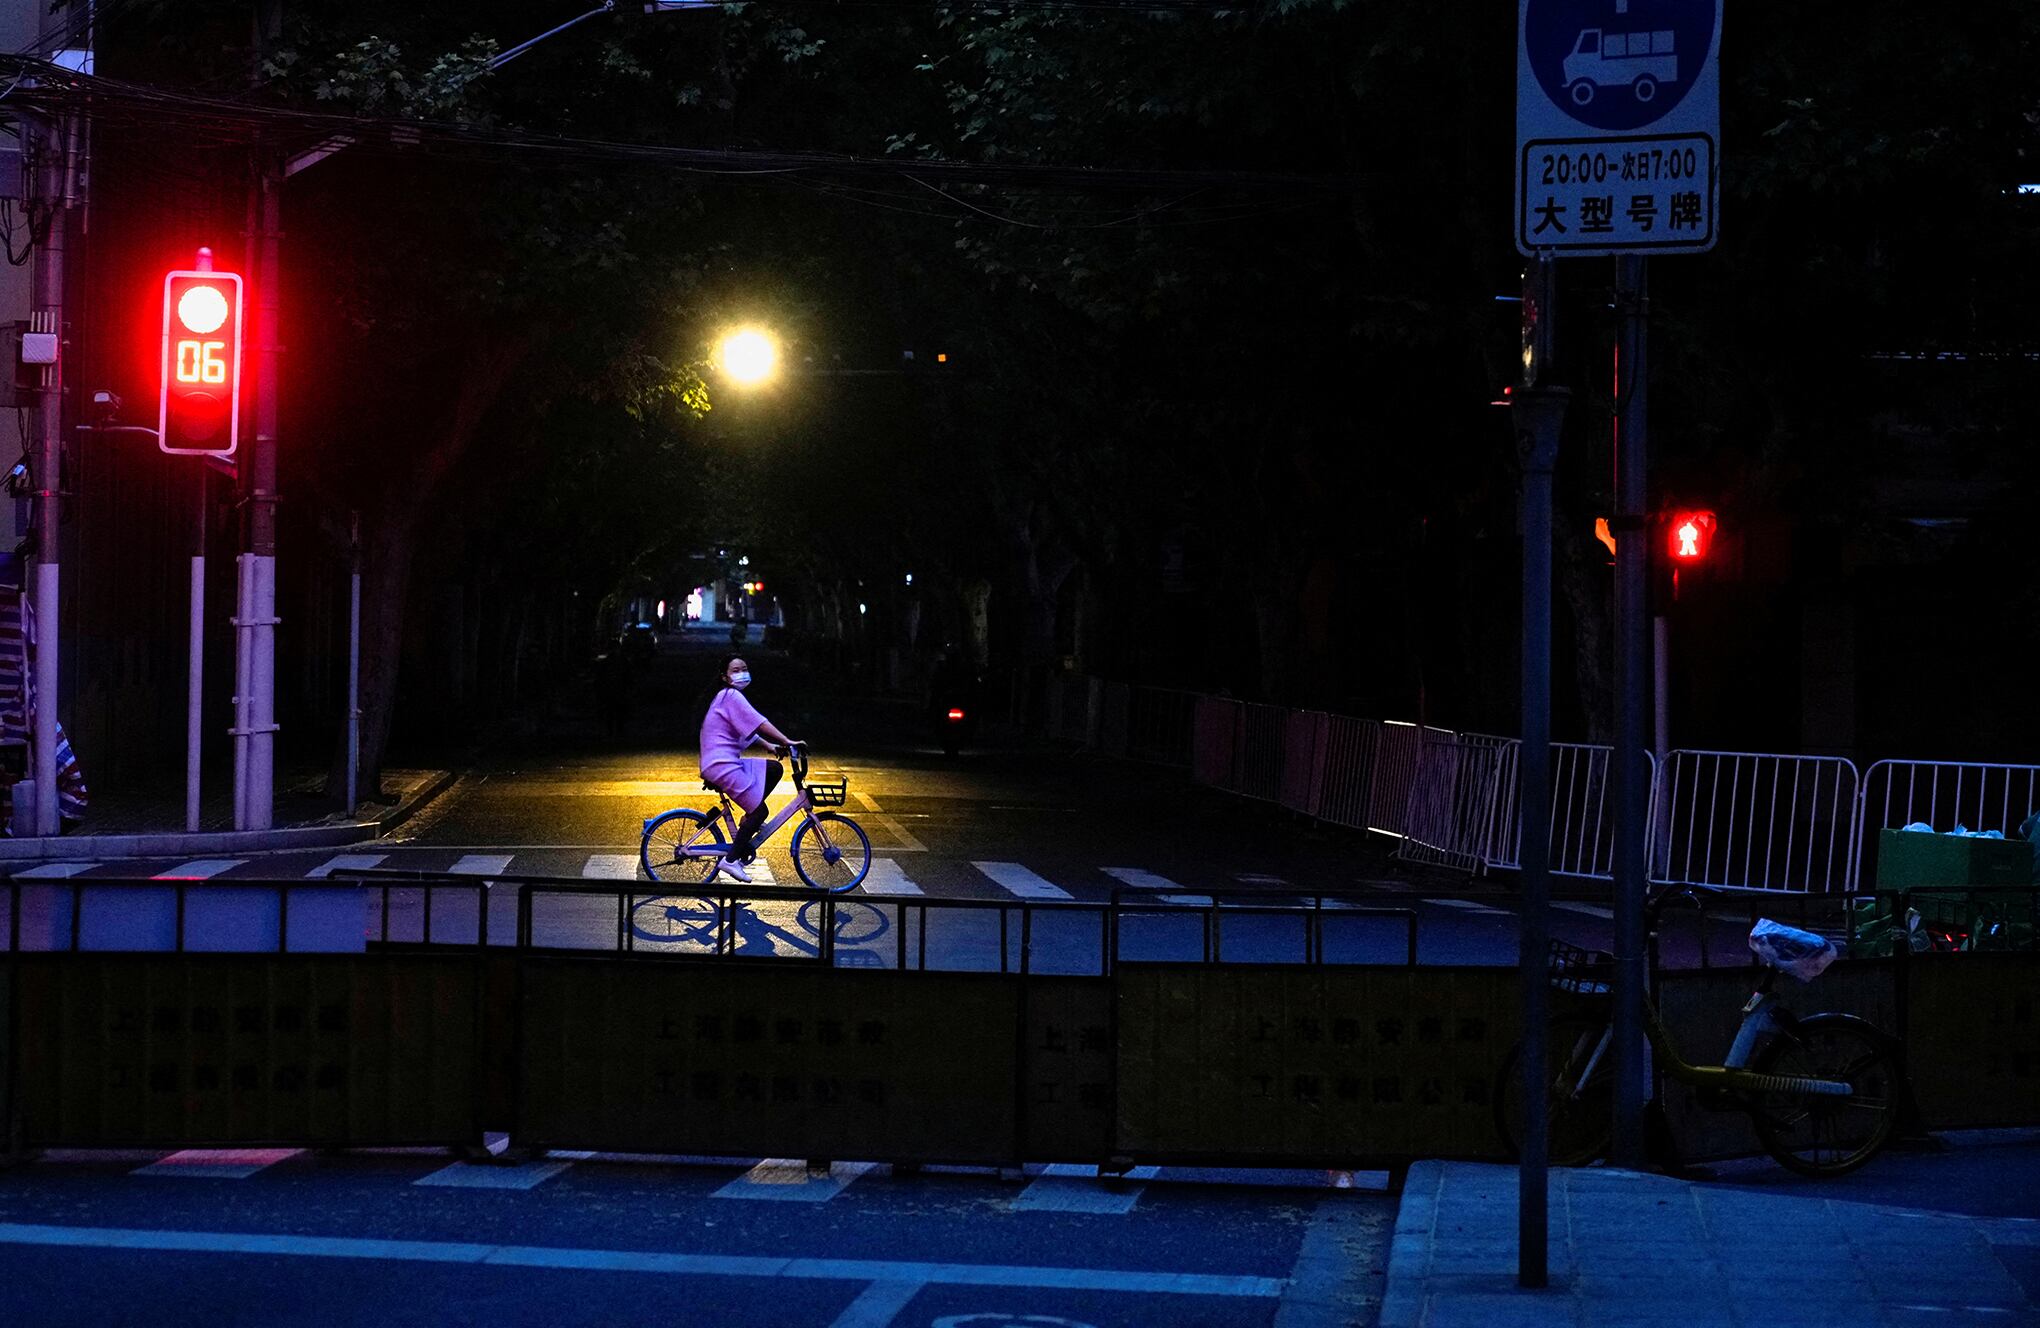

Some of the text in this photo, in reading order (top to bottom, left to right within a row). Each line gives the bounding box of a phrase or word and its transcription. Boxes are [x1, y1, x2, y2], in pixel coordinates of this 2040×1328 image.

[1542, 149, 1696, 185] 20:00-次日7:00
[1533, 190, 1702, 235] 大型号牌
[177, 340, 225, 384] 06
